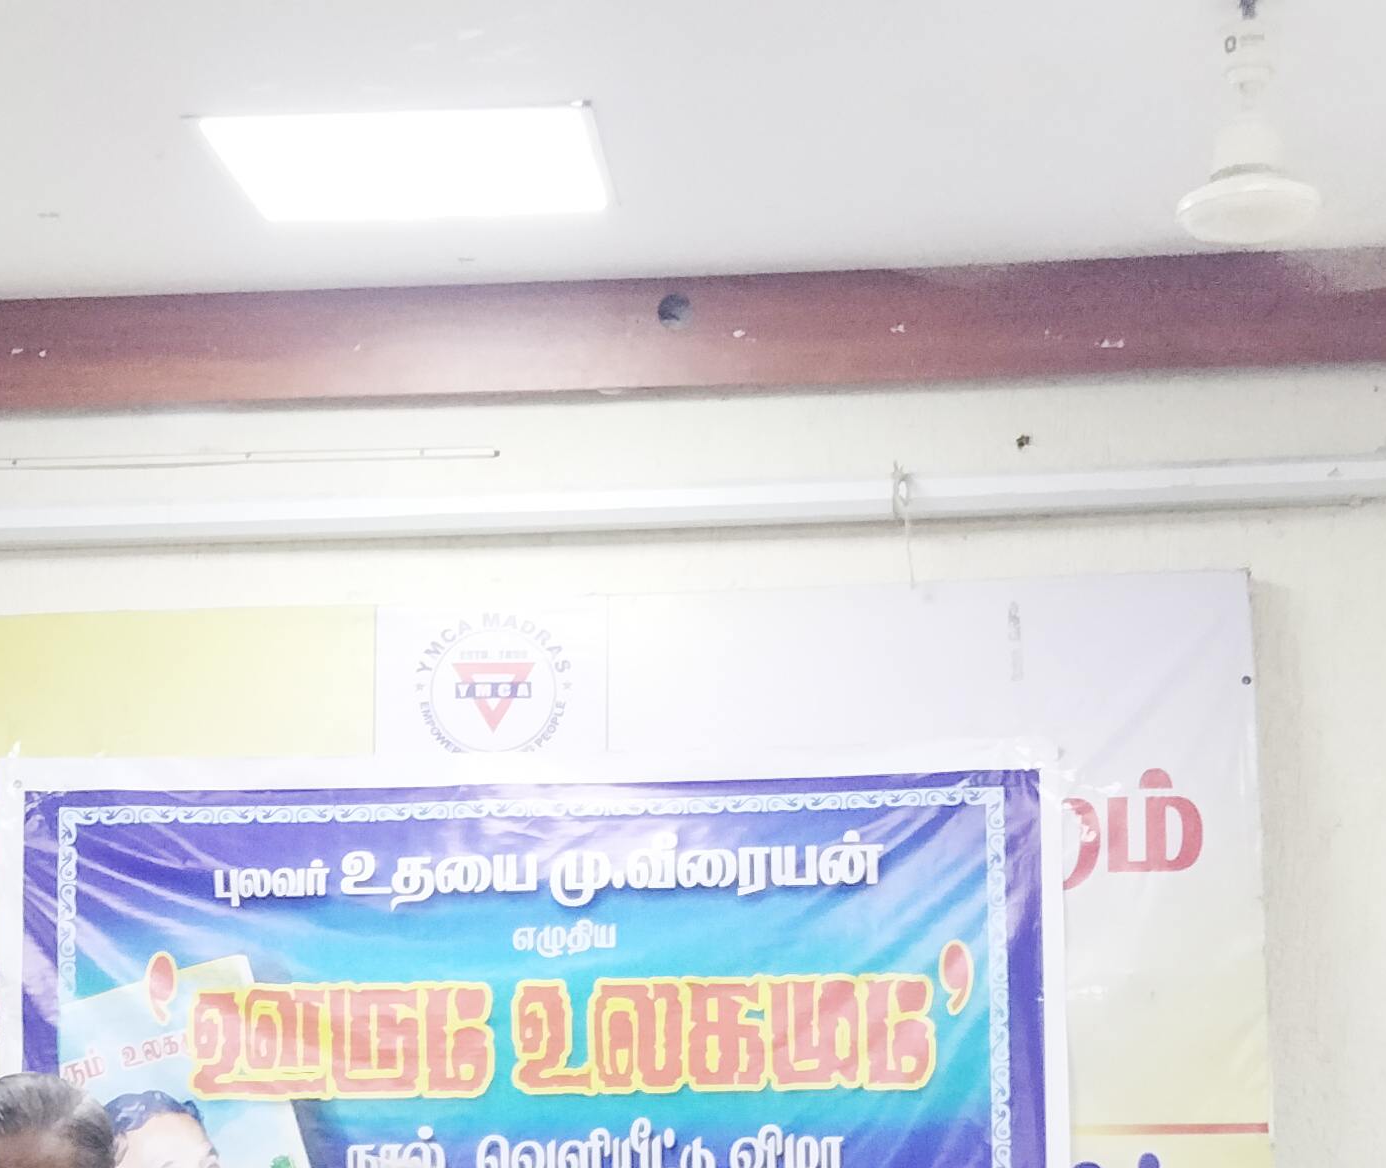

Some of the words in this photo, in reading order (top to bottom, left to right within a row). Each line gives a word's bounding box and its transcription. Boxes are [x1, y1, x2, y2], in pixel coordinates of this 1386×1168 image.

[416, 619, 474, 673] YMCA
[481, 613, 572, 673] MADRAS
[457, 682, 531, 698] YMCA
[534, 700, 567, 748] PEOPLE
[214, 858, 331, 907] புலவர்
[340, 850, 539, 912] உதயை
[549, 829, 884, 907] மு.வீரையன்
[513, 918, 617, 957] எழுதிய
